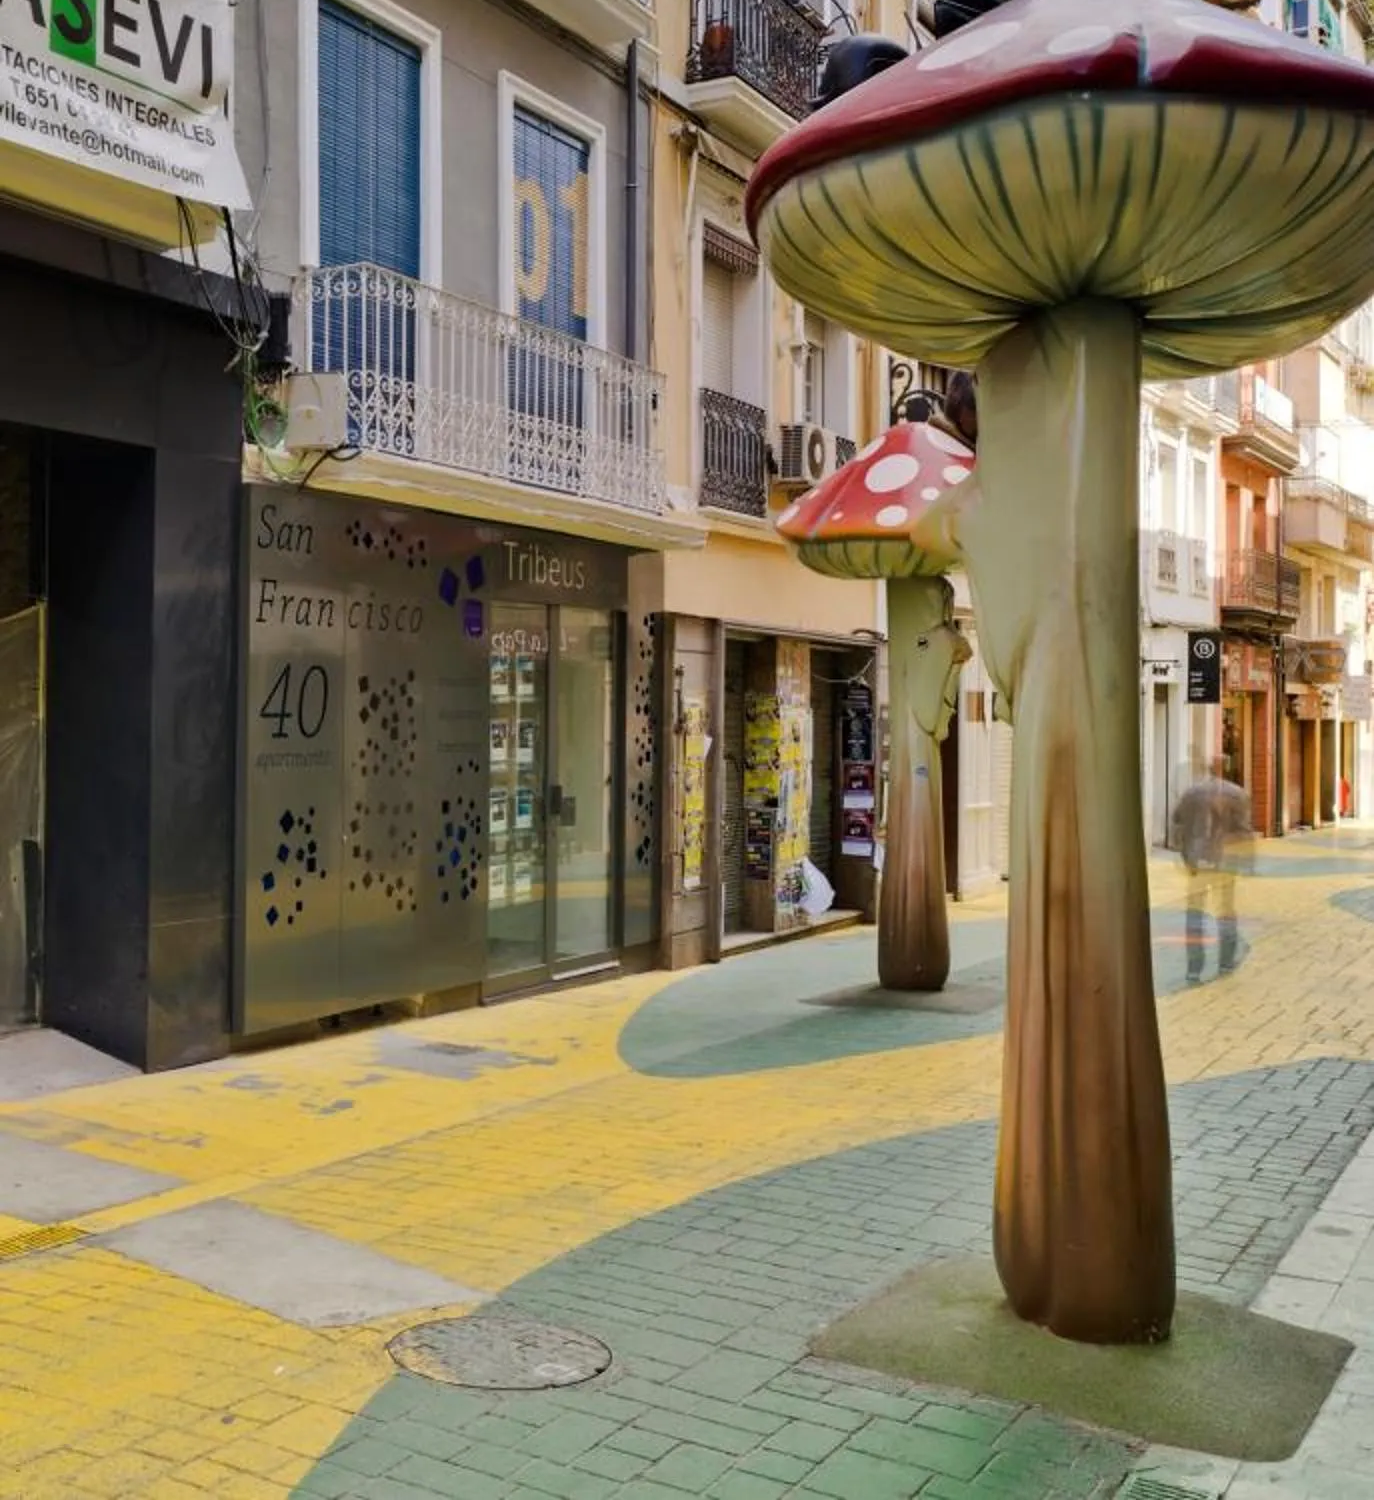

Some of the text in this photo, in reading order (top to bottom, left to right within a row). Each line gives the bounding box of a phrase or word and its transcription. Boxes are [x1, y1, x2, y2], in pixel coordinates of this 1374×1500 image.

[0, 43, 99, 104] TACIONES
[105, 88, 216, 147] INTEGRALES
[514, 171, 588, 318] 01
[257, 504, 315, 554] San
[503, 541, 586, 589] Tribeus
[259, 662, 329, 738] 40
